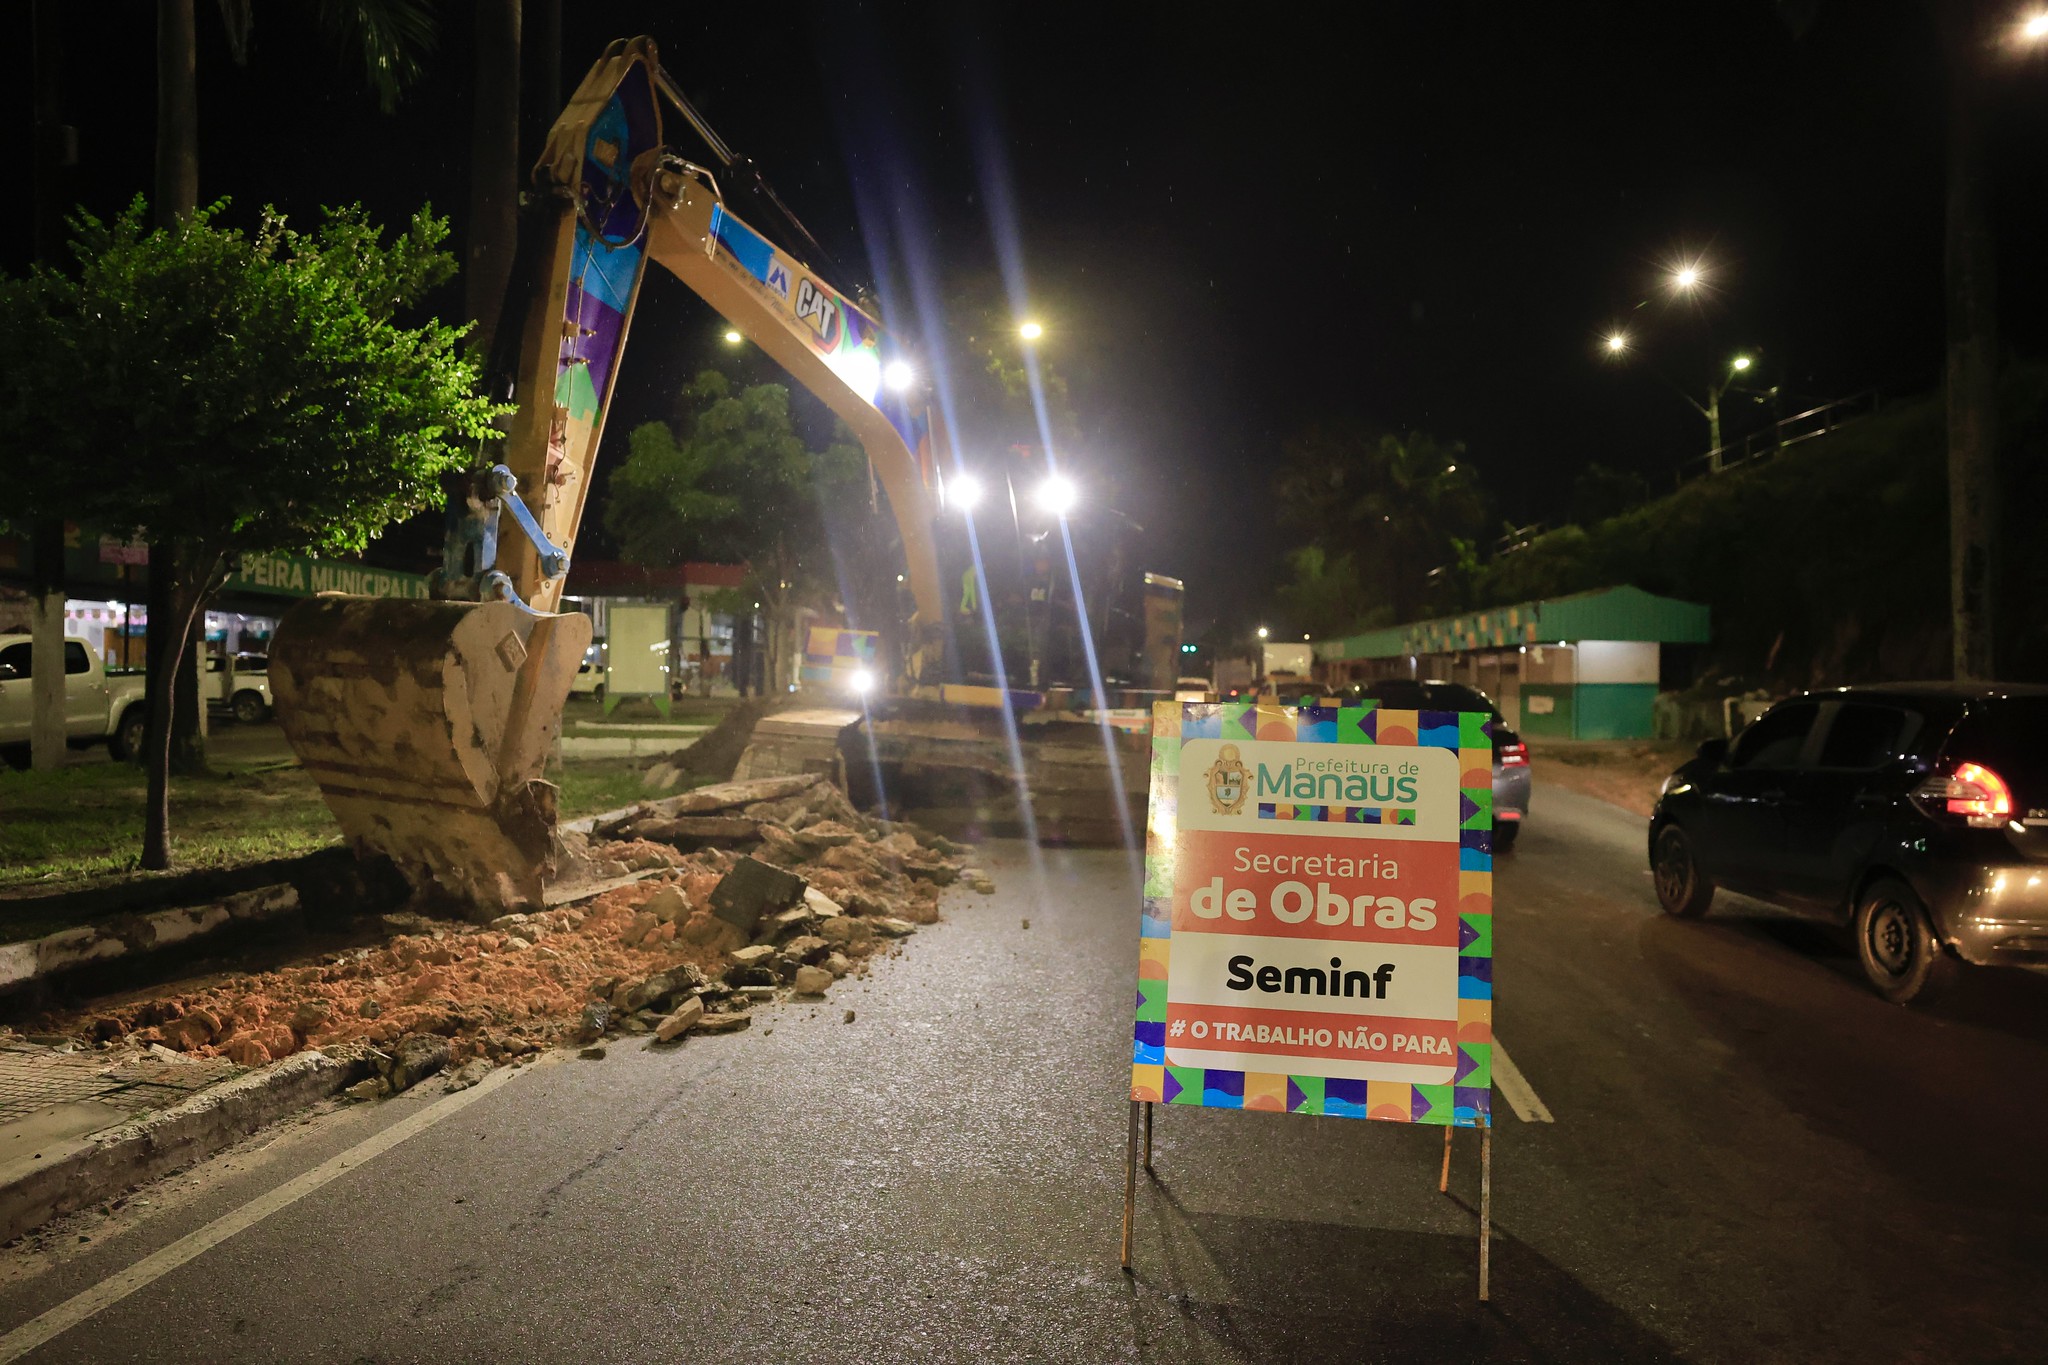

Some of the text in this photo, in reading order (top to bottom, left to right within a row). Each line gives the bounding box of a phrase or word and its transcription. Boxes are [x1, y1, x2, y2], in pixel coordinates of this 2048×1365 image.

[796, 279, 836, 339] CAT
[310, 565, 410, 599] MUNICIPAL
[1257, 762, 1418, 803] Manaus
[1296, 757, 1419, 775] Prefeitura de
[1233, 847, 1399, 880] Secretaria
[1190, 876, 1437, 931] de Obras
[1226, 955, 1396, 999] Seminf
[1190, 1021, 1208, 1039] O
[1212, 1022, 1333, 1047] TRABALHO
[1337, 1026, 1387, 1051] NÃO
[1392, 1034, 1453, 1056] PARA
